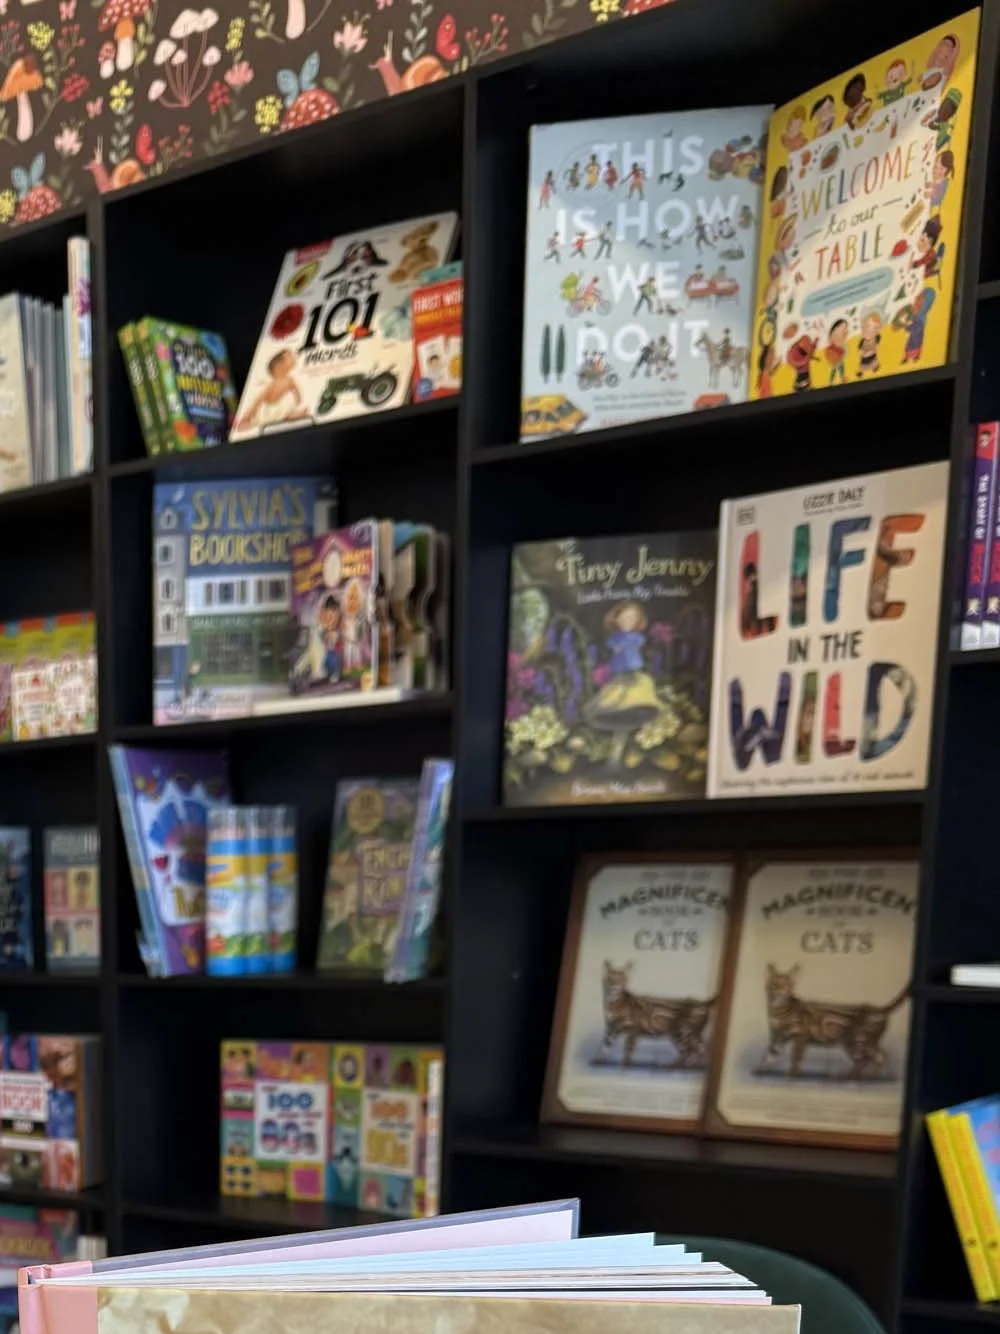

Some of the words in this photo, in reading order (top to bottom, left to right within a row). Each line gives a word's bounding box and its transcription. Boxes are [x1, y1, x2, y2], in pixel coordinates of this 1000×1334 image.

[593, 136, 704, 177] THIS
[801, 140, 919, 220] WELCOME
[556, 208, 597, 245] IS
[615, 196, 739, 242] HOW
[825, 211, 847, 237] to
[850, 205, 878, 232] our
[815, 225, 886, 281] TABLE
[608, 261, 680, 303] WE
[298, 291, 379, 354] 101
[577, 325, 640, 364] DO
[671, 320, 710, 358] IT
[191, 485, 306, 531] SYLVIA'S
[556, 545, 623, 590] Tiny
[626, 543, 714, 586] Jenny
[739, 514, 926, 640] LIFE
[788, 639, 808, 664] IN
[820, 631, 863, 662] THE
[728, 662, 918, 771] WILD
[634, 928, 700, 953] CATS
[801, 930, 874, 955] CATS
